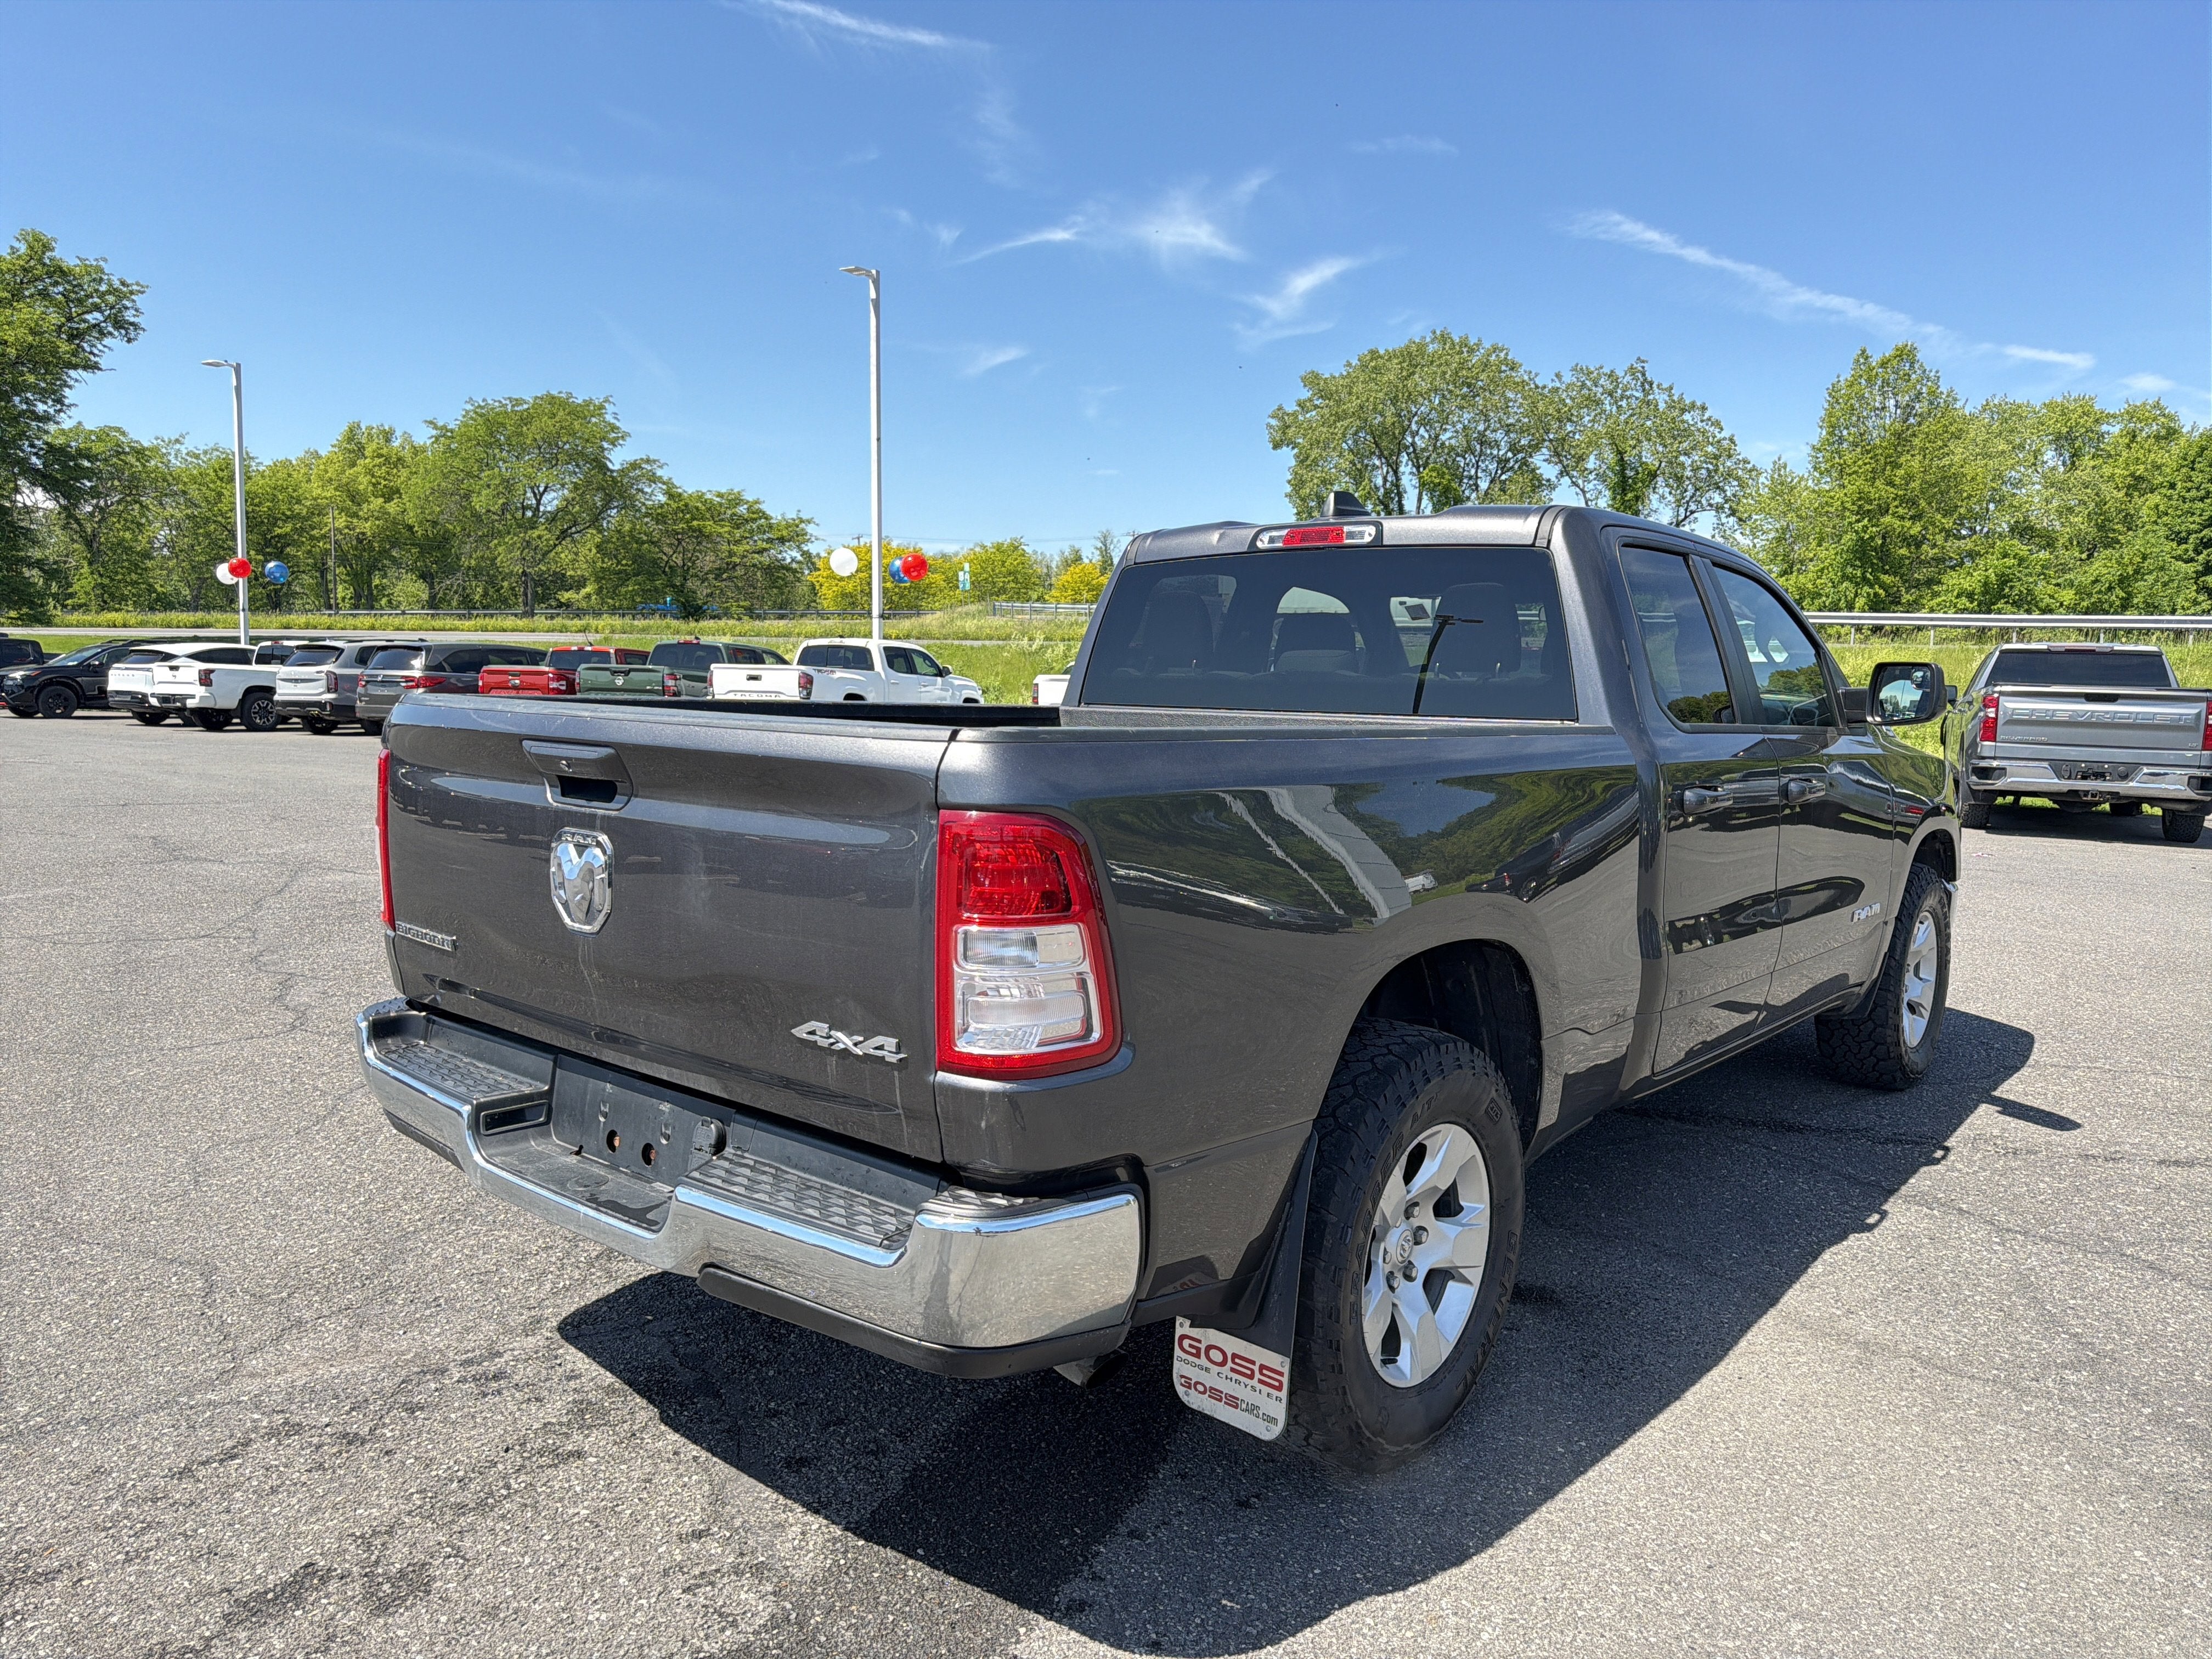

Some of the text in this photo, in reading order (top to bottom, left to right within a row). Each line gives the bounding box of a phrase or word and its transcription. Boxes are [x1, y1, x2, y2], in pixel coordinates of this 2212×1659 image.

[2012, 709, 2192, 724] CHEVROLET
[561, 832, 596, 845] RAM
[1850, 902, 1881, 924] RAM
[1177, 1334, 1285, 1393] GOSS
[1176, 1355, 1284, 1404] DODGE CHRYSLER
